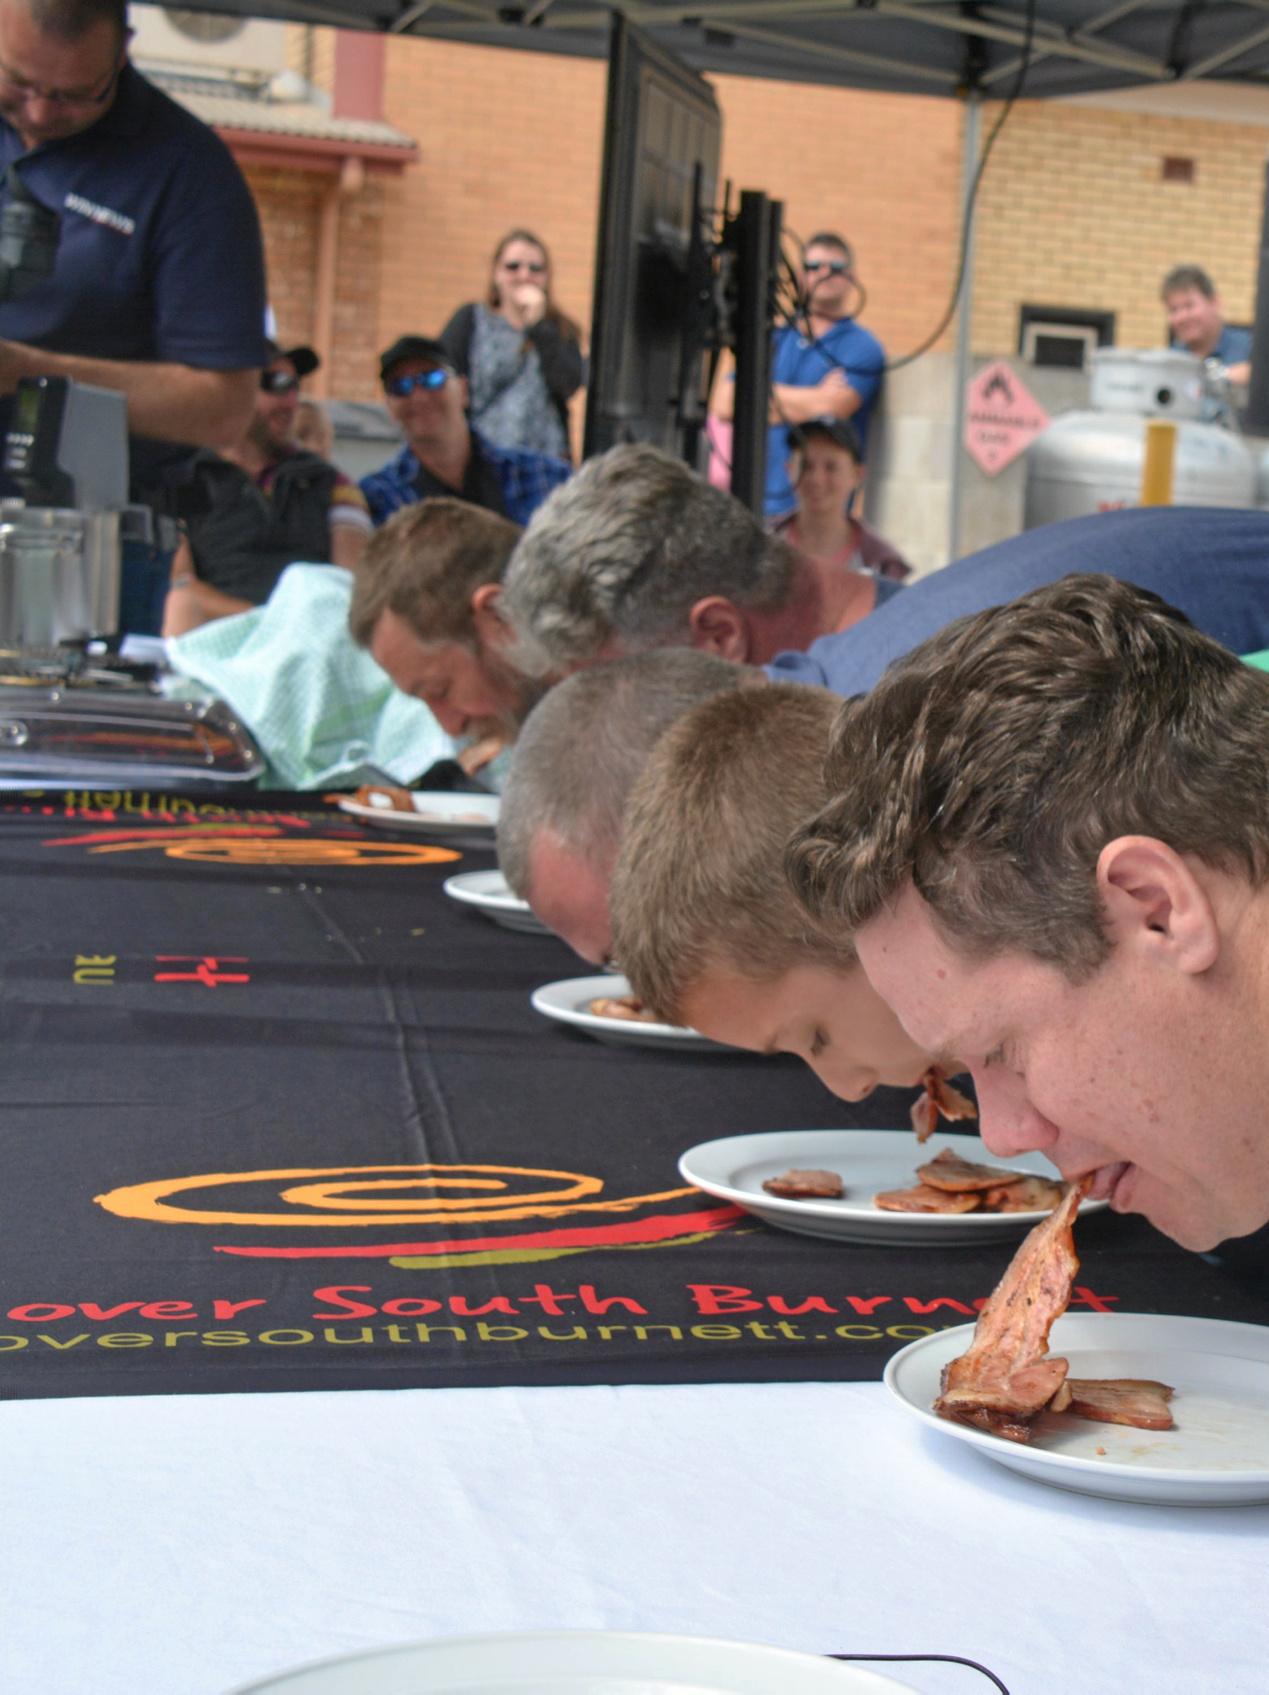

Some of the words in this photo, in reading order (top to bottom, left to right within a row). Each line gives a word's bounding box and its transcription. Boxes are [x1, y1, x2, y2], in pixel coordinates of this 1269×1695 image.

[7, 1299, 267, 1323] over
[312, 1284, 649, 1320] South
[686, 1283, 1120, 1315] Burnt
[0, 1322, 948, 1351] oversouthburnett.co
